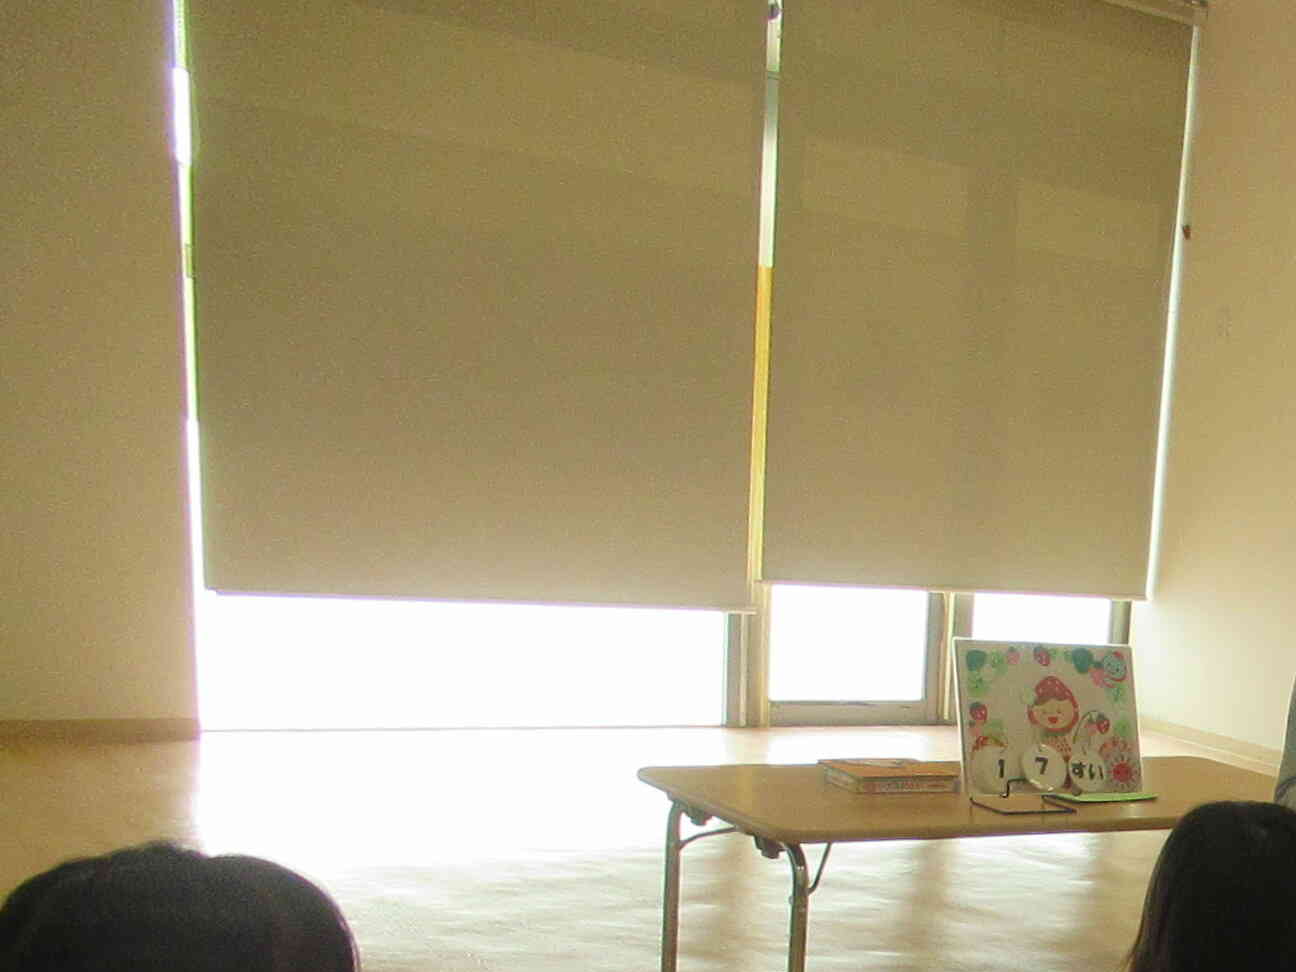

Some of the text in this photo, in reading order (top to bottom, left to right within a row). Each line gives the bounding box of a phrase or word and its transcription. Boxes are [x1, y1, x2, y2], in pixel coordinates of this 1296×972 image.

[998, 756, 1104, 780] 1 7 すい
